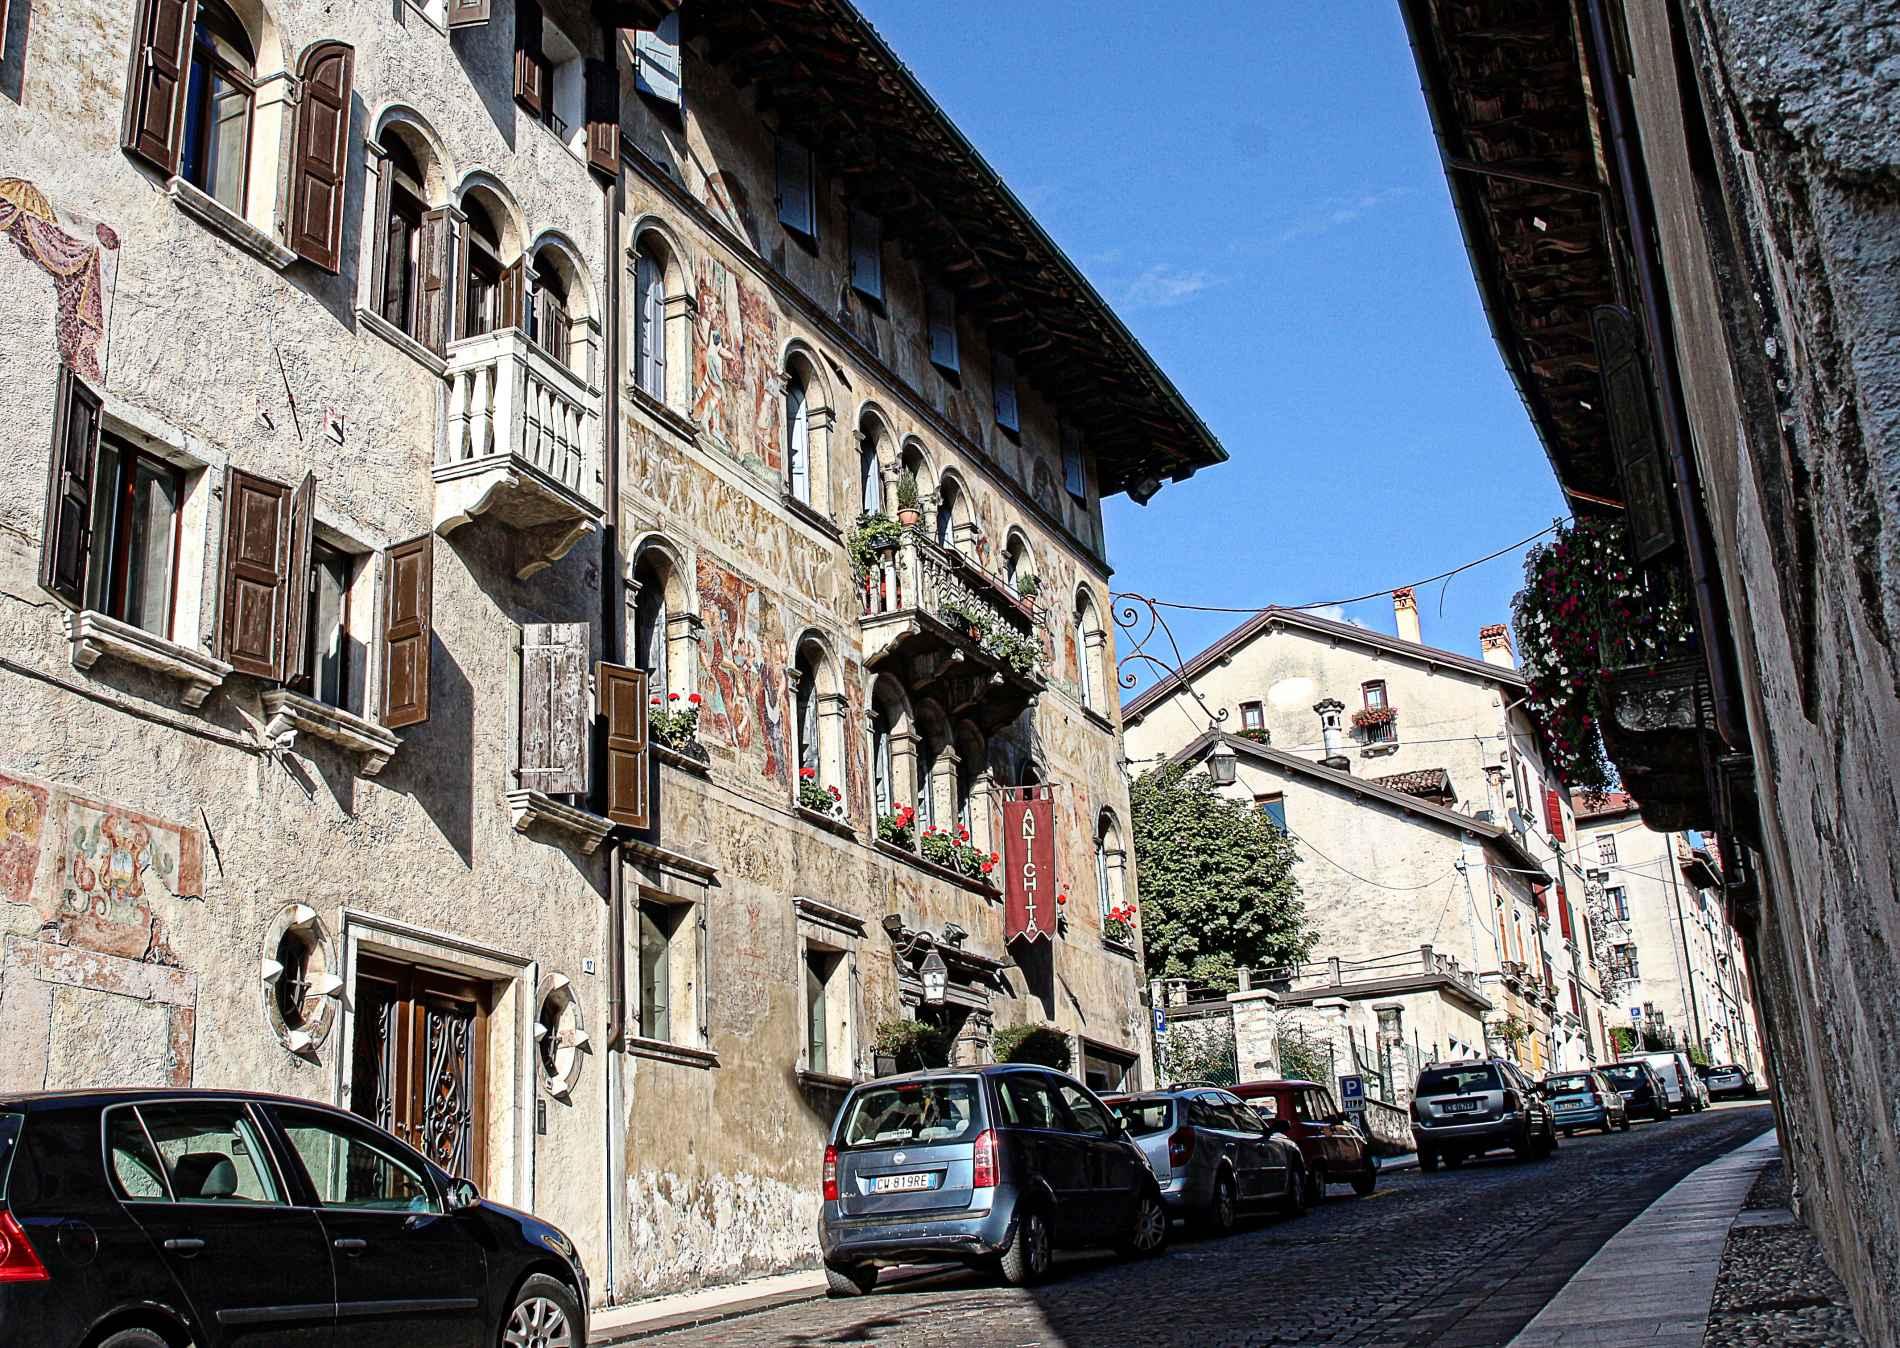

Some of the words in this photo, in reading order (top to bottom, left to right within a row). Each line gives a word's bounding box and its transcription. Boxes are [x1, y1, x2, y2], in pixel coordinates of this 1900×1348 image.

[1023, 808, 1038, 933] ANTICHITÀ
[1156, 1011, 1164, 1028] P
[1346, 1081, 1357, 1095] P
